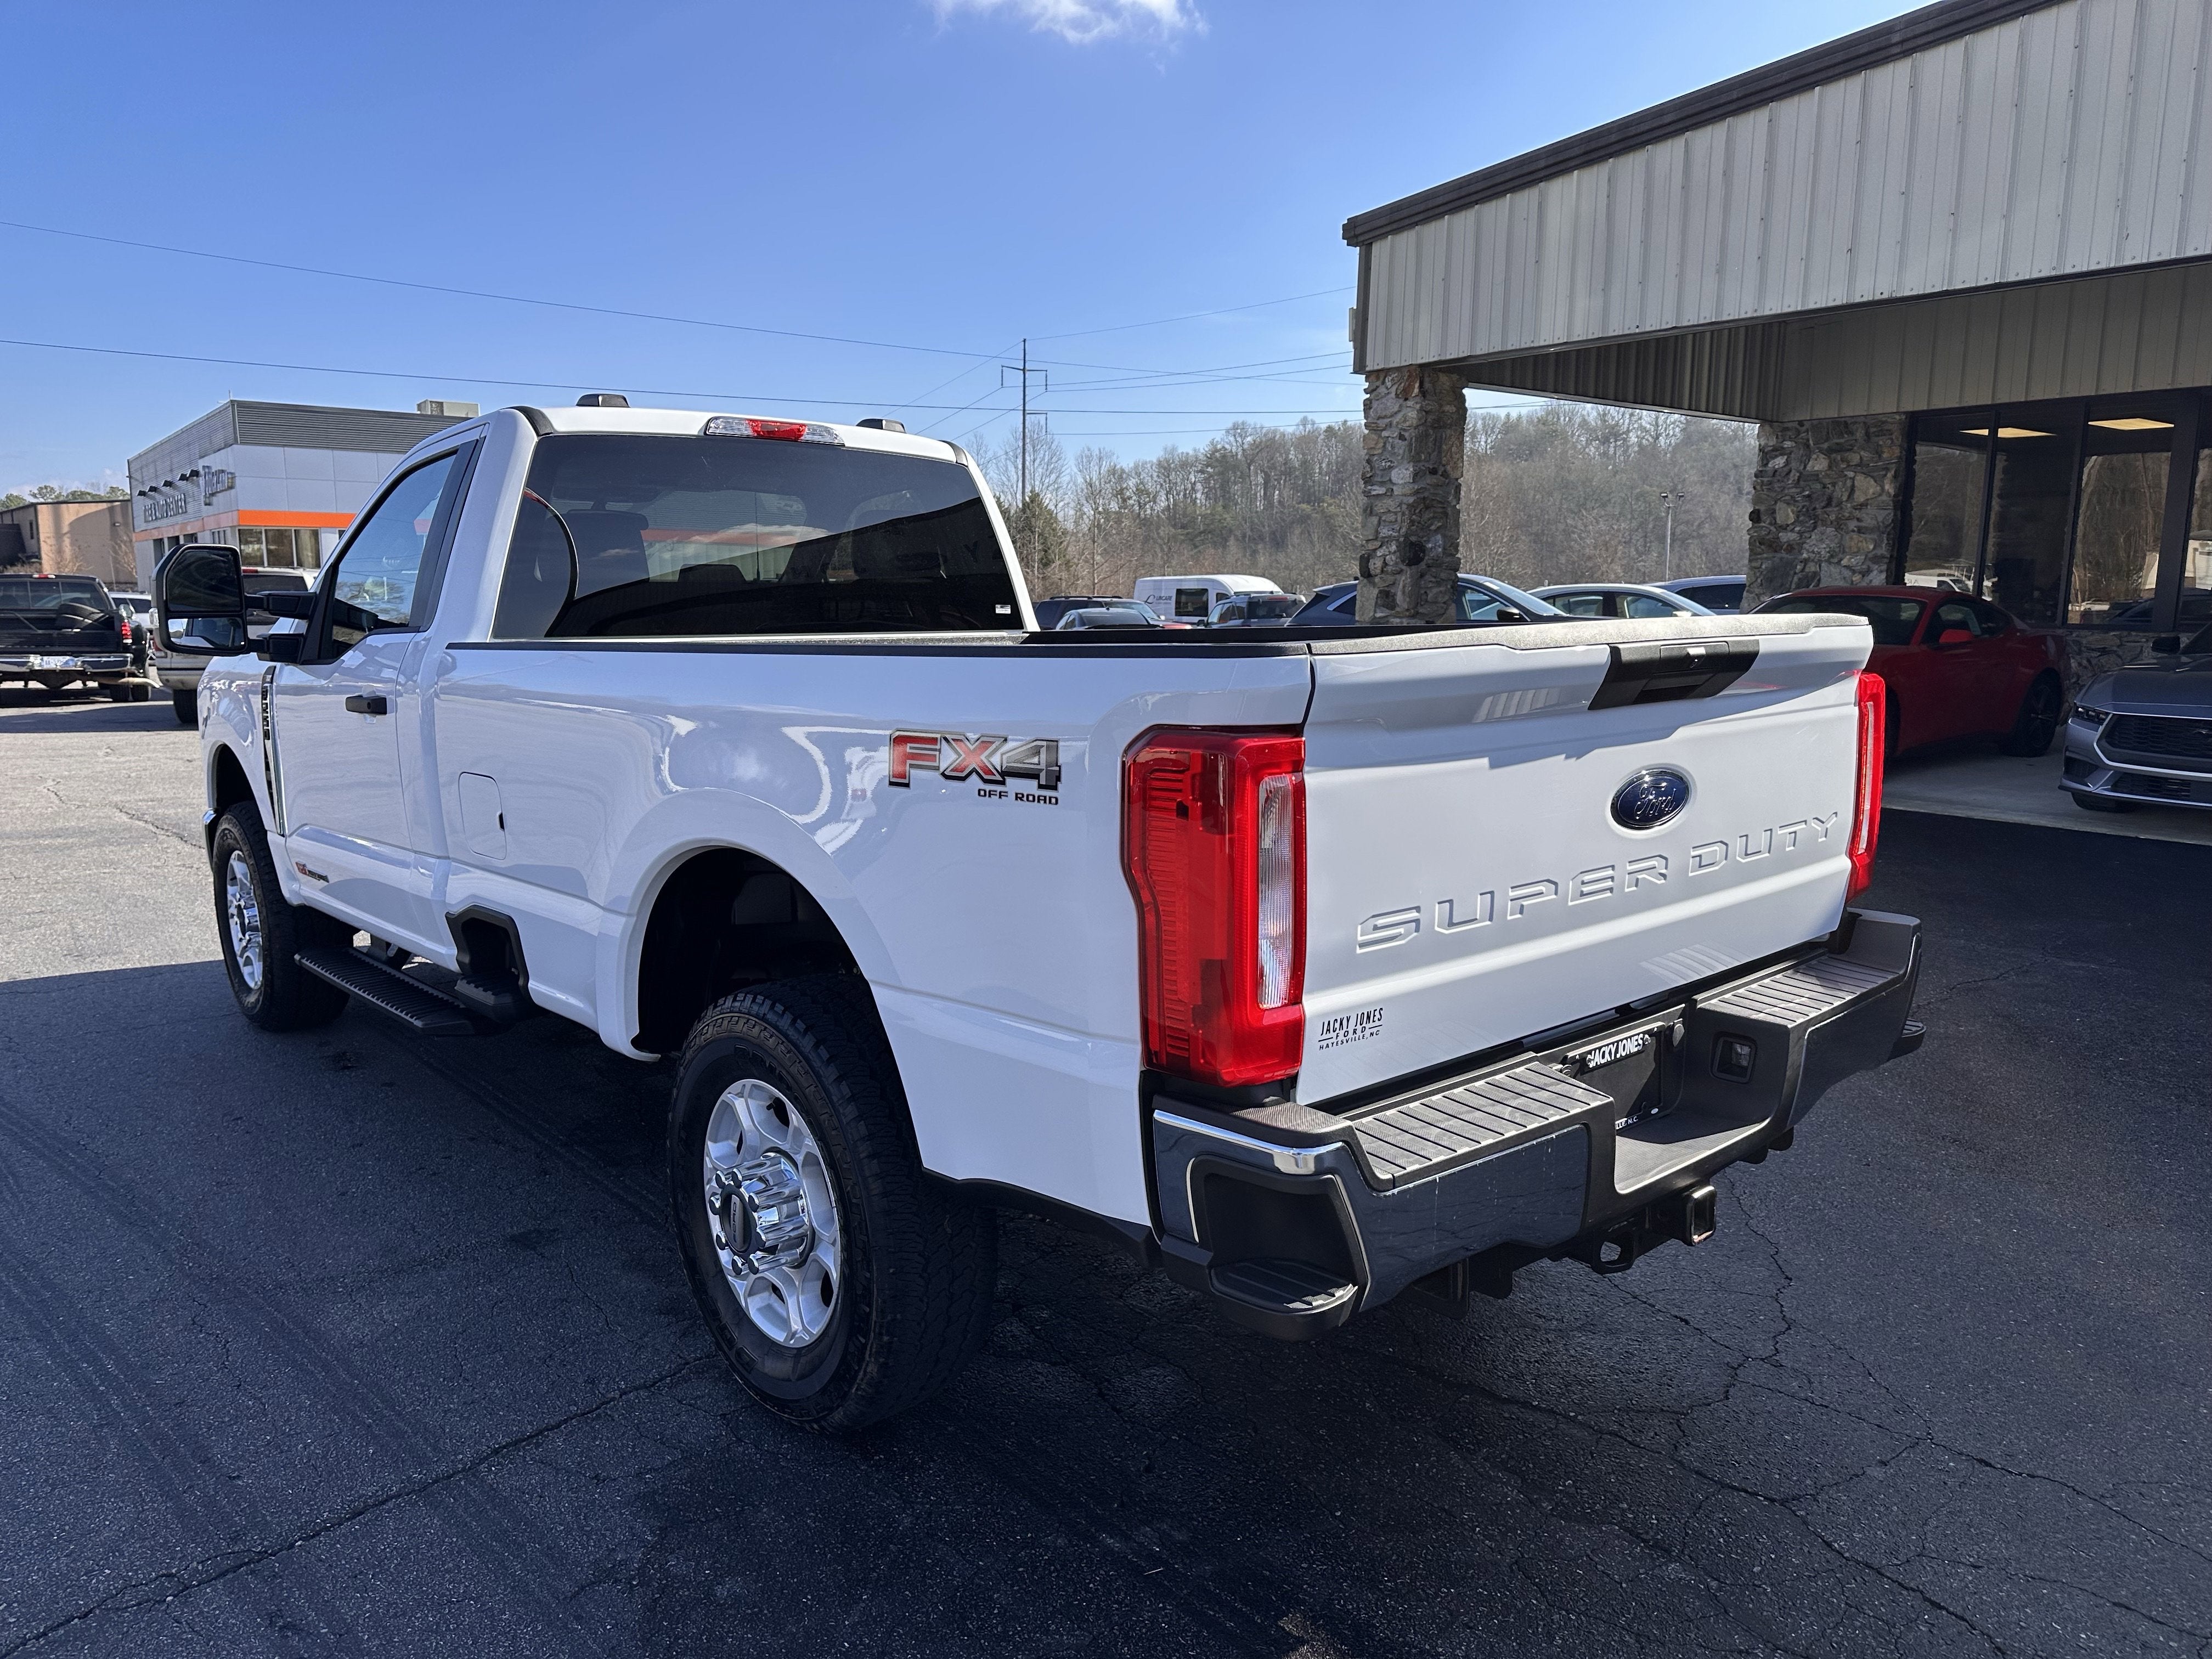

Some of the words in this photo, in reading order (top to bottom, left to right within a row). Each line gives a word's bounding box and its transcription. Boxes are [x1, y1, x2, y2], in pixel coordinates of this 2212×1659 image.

[888, 727, 1063, 792] FX4
[977, 788, 1008, 799] OFF
[1015, 792, 1059, 805] ROAD
[1634, 782, 1677, 820] Ford
[1356, 854, 1668, 953] SUPER
[1689, 812, 1838, 877] DUTY
[1320, 1015, 1351, 1036] JACKY
[1354, 1007, 1383, 1028] JONES
[1336, 1026, 1366, 1040] FORD
[1589, 1042, 1617, 1068] JACKY
[1616, 1033, 1644, 1058] JONES
